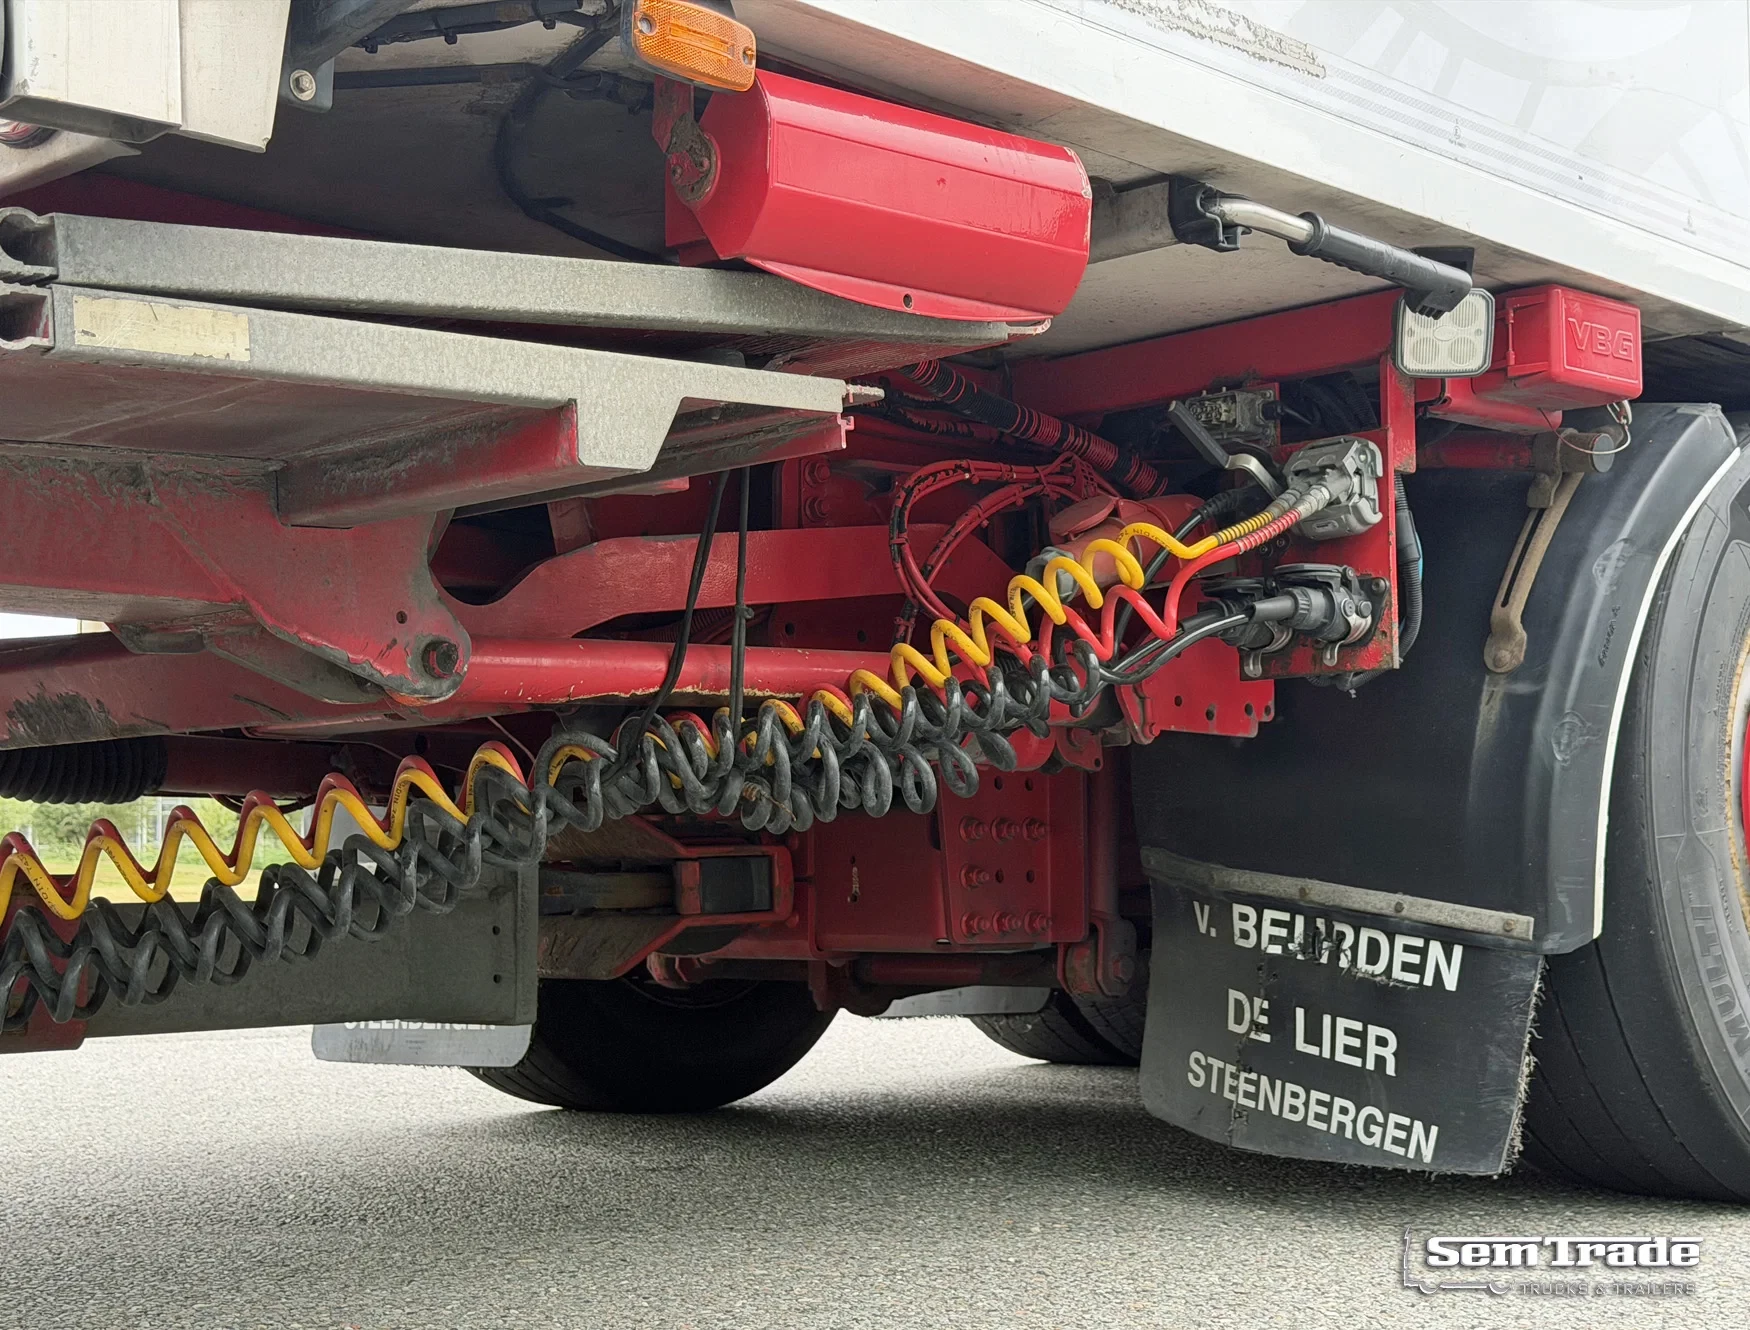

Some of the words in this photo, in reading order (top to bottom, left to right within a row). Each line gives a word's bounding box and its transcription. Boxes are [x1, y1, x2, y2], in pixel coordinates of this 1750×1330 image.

[1568, 317, 1634, 361] VBG
[1232, 903, 1463, 991] BEURDEN
[1227, 988, 1271, 1043] DE
[1295, 1007, 1399, 1076] LIER
[1187, 1051, 1439, 1164] STEENBERGEN
